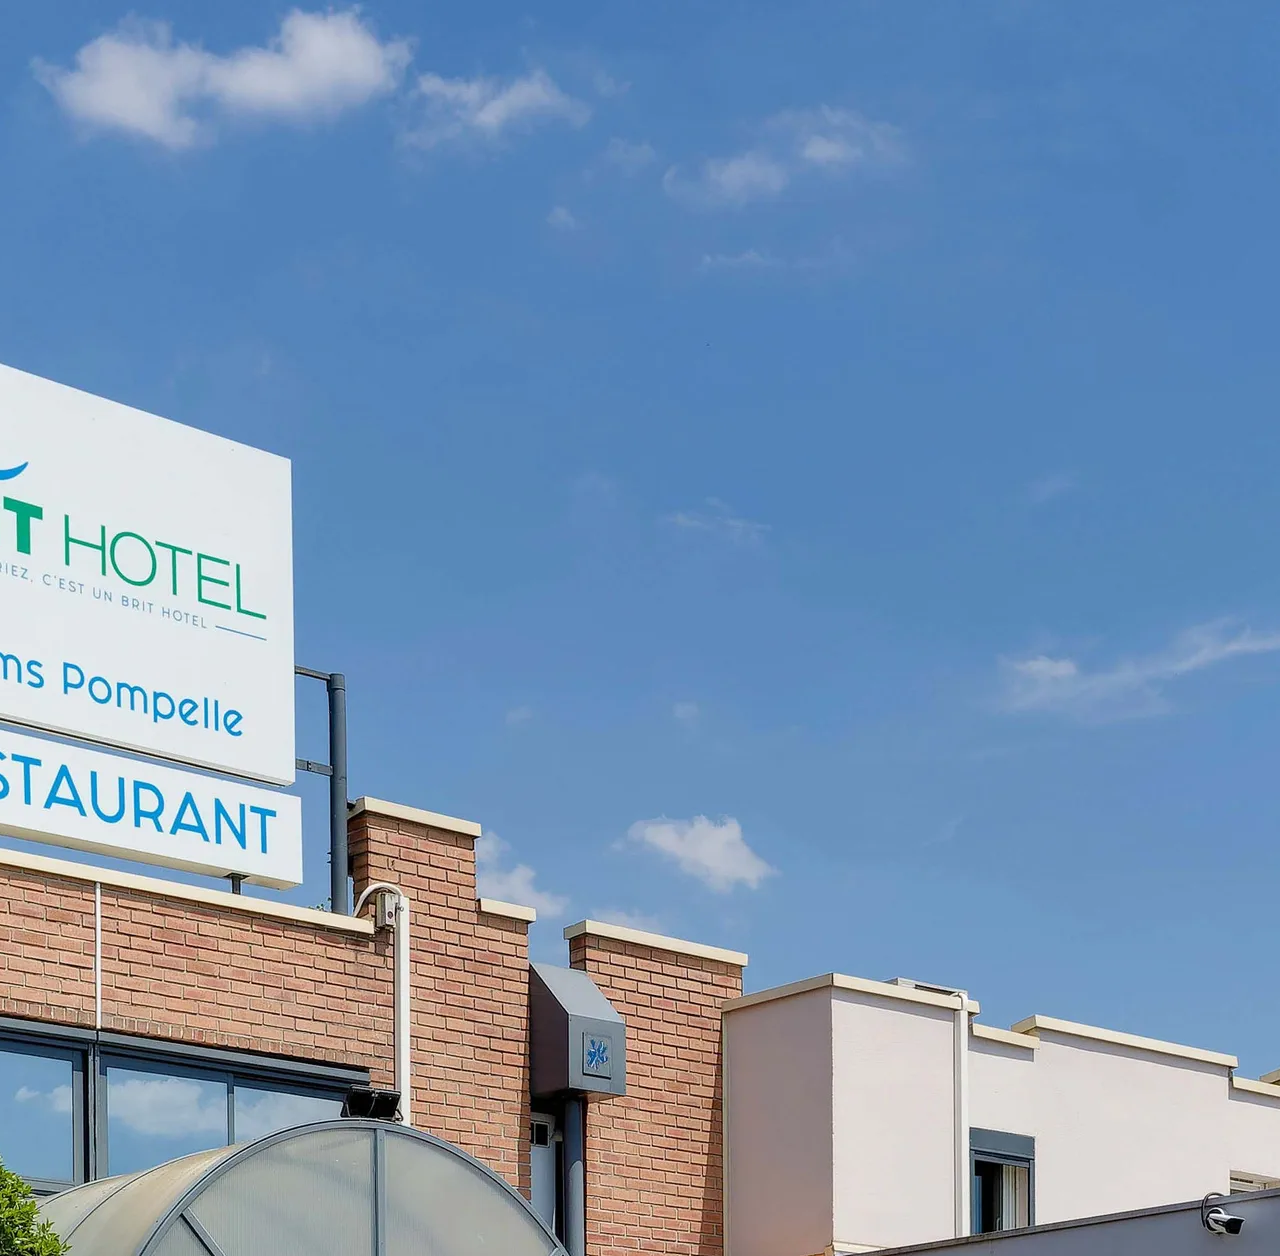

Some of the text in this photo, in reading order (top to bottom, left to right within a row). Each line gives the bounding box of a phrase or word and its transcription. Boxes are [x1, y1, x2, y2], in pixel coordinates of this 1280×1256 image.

[42, 574, 84, 596] C'EST
[93, 587, 113, 602] UN
[122, 595, 155, 615] BRIT
[162, 606, 208, 629] HOTEL
[64, 514, 268, 621] HOTEL
[63, 661, 244, 738] Pompelle
